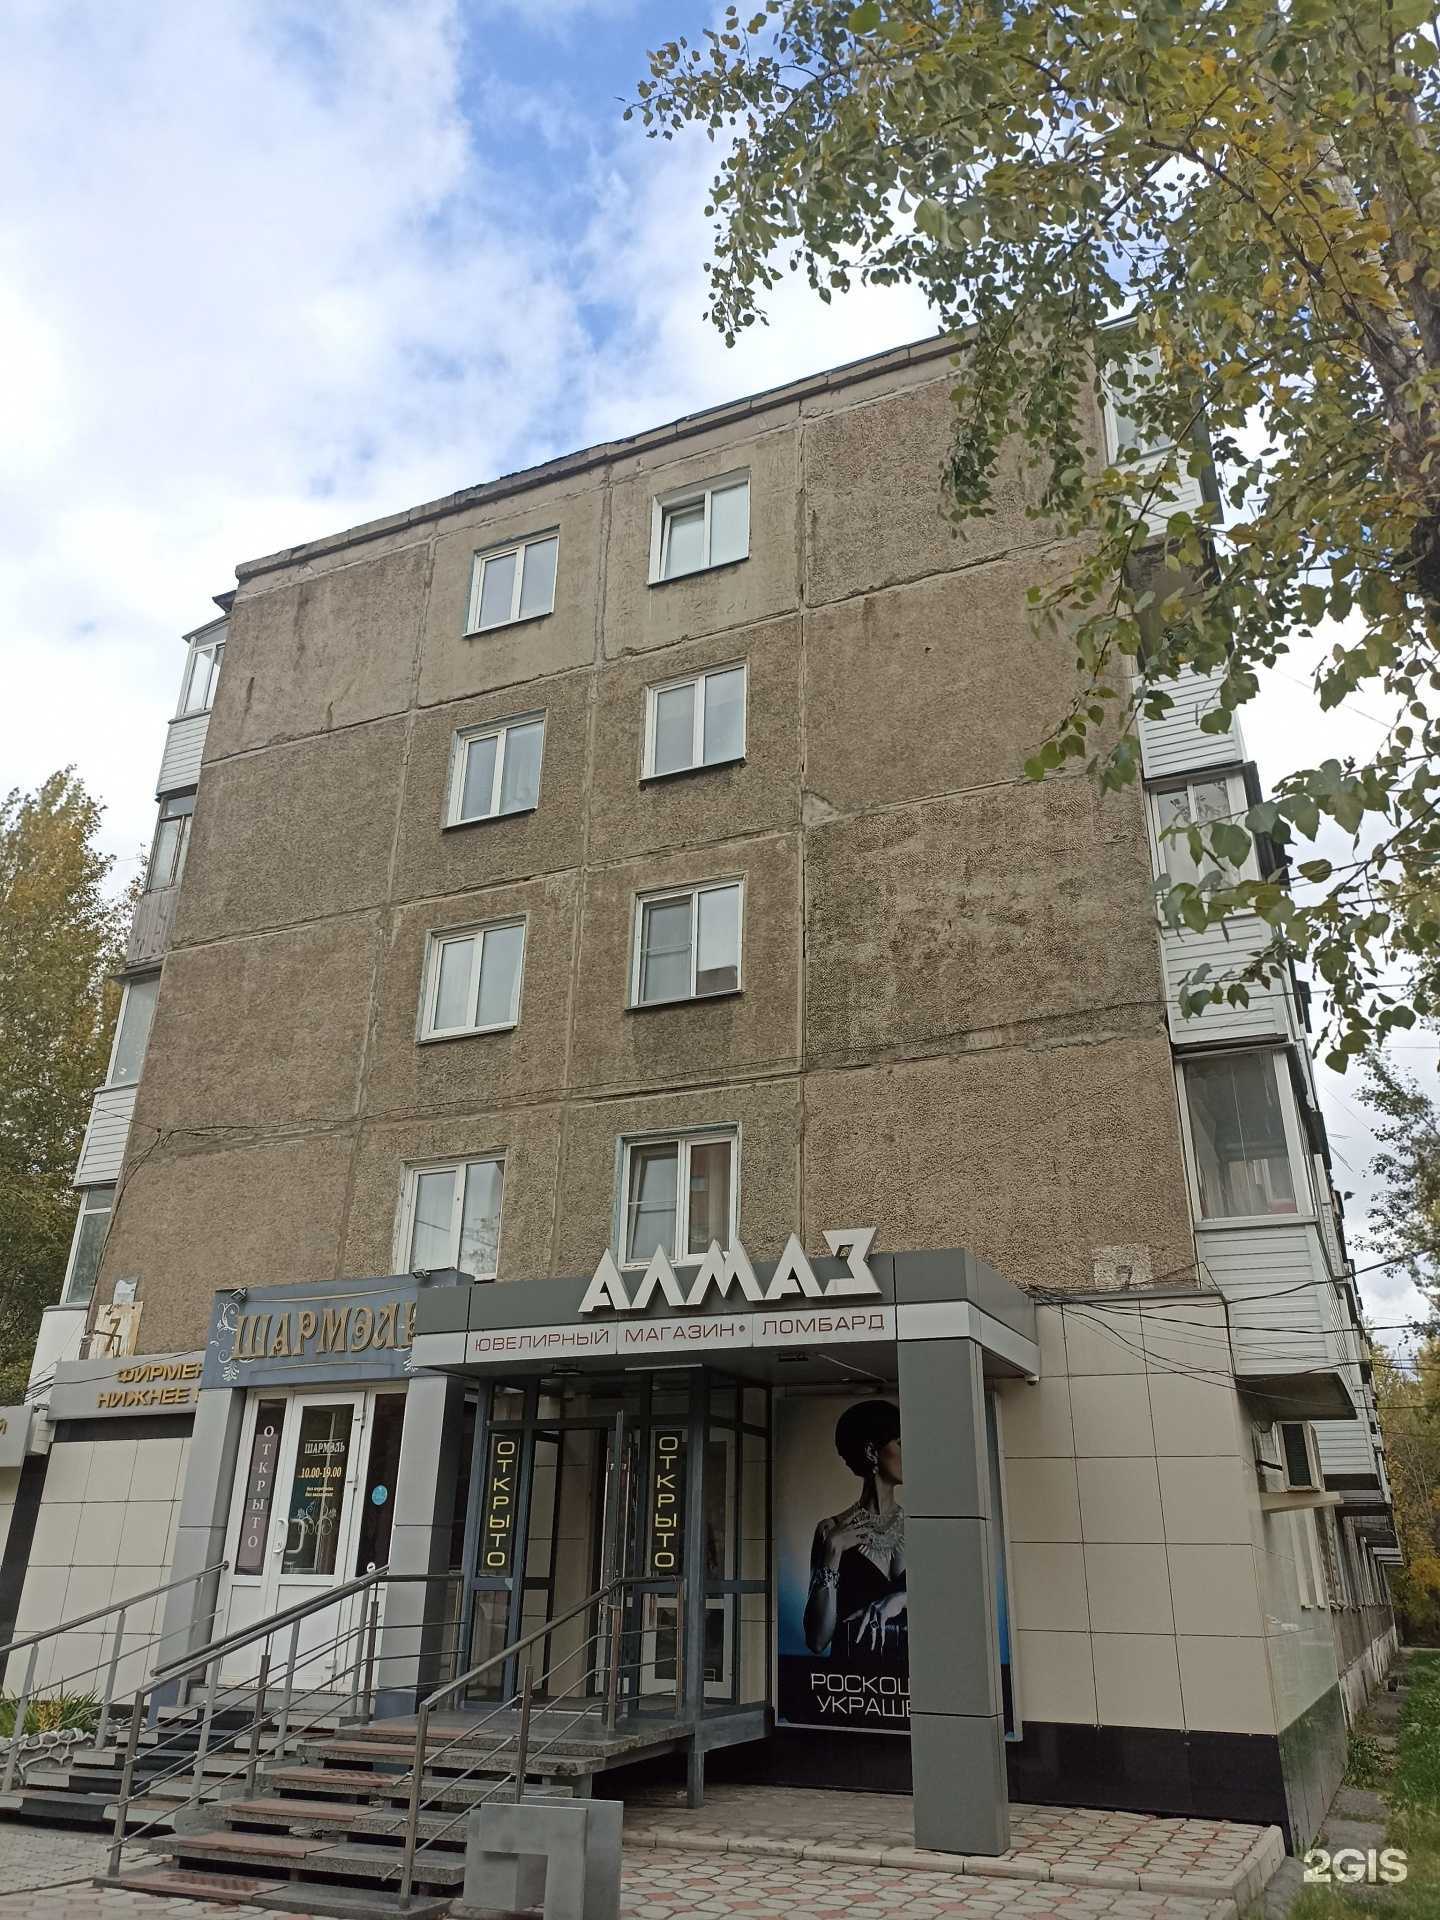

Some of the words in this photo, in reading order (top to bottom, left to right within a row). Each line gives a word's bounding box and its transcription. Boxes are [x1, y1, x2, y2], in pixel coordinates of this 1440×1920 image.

[578, 1227, 882, 1313] АЛМАЗ
[105, 1318, 121, 1352] 7
[475, 1328, 609, 1352] ЮВЕЛИРНЫЙ
[625, 1323, 735, 1343] МАГАЗИН
[762, 1314, 885, 1336] ЛОМБАРД
[96, 1388, 191, 1408] НИЖНЕЕ
[247, 1425, 275, 1548] ОТКРЫТО
[487, 1441, 515, 1566] ОТКРЫТО
[654, 1436, 678, 1568] ОТКРЫТО
